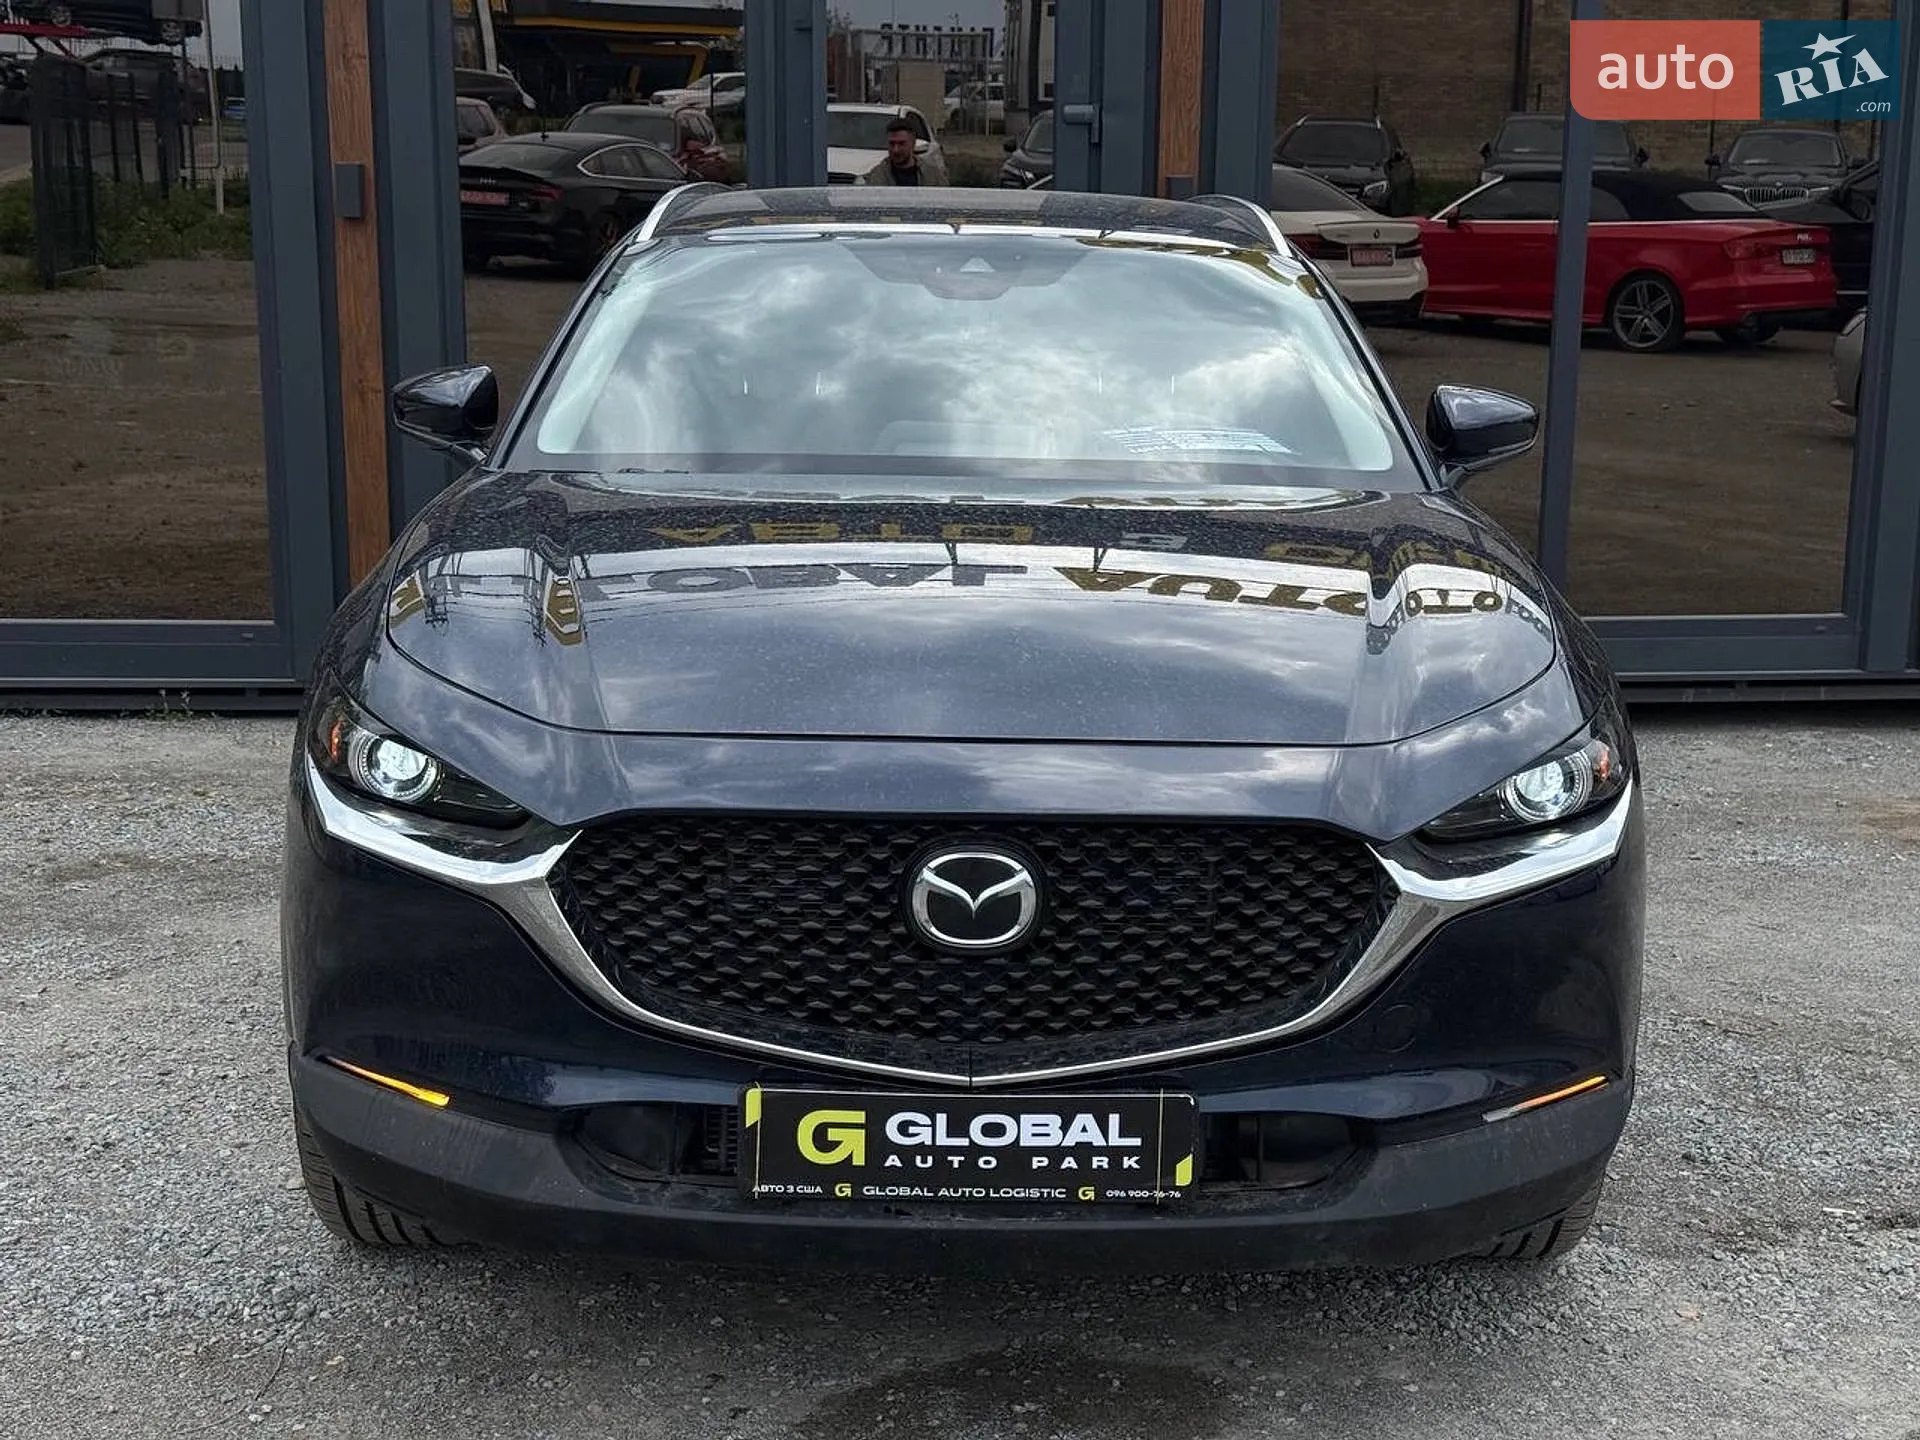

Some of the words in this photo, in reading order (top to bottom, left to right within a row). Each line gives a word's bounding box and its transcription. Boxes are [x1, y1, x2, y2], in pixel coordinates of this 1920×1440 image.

[885, 1111, 1142, 1147] GLOBAL
[884, 1154, 998, 1169] AUTO
[1031, 1156, 1141, 1170] PARK
[862, 1186, 934, 1197] GLOBAL
[937, 1187, 986, 1198] AUTO
[989, 1188, 1067, 1199] LOGISTIC
